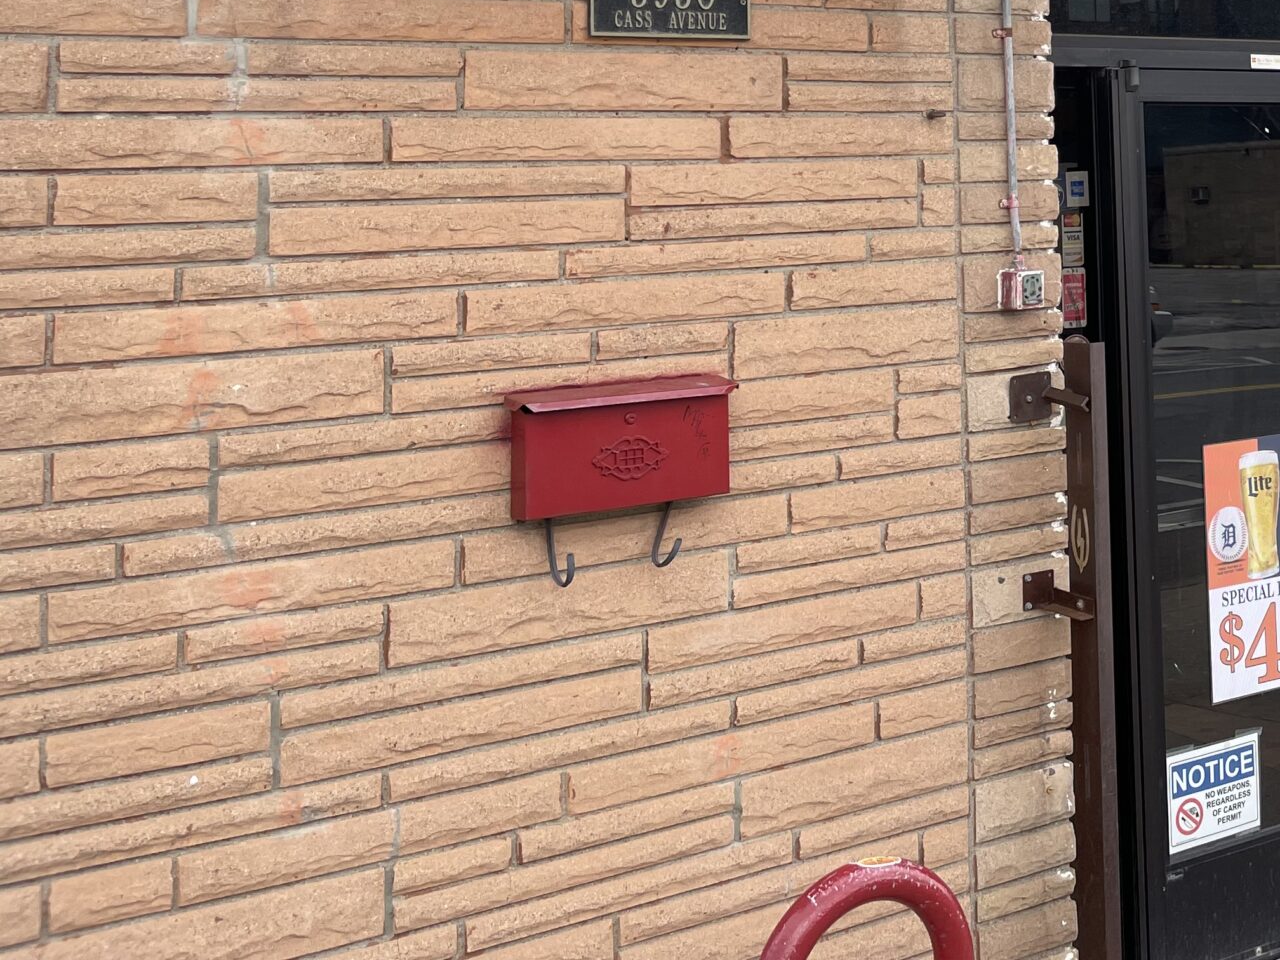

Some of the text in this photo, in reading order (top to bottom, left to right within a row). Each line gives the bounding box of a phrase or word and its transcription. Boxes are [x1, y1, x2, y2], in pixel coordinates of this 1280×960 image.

[614, 9, 727, 31] CASS AVENUE
[1247, 475, 1272, 498] Lite
[1221, 583, 1275, 607] SPECIAL
[1171, 749, 1254, 794] NOTICE
[1205, 790, 1216, 799] NO
[1206, 789, 1251, 809] REGARDLESS
[1212, 800, 1247, 817] OF CARRY
[1217, 811, 1242, 825] PERMIT
